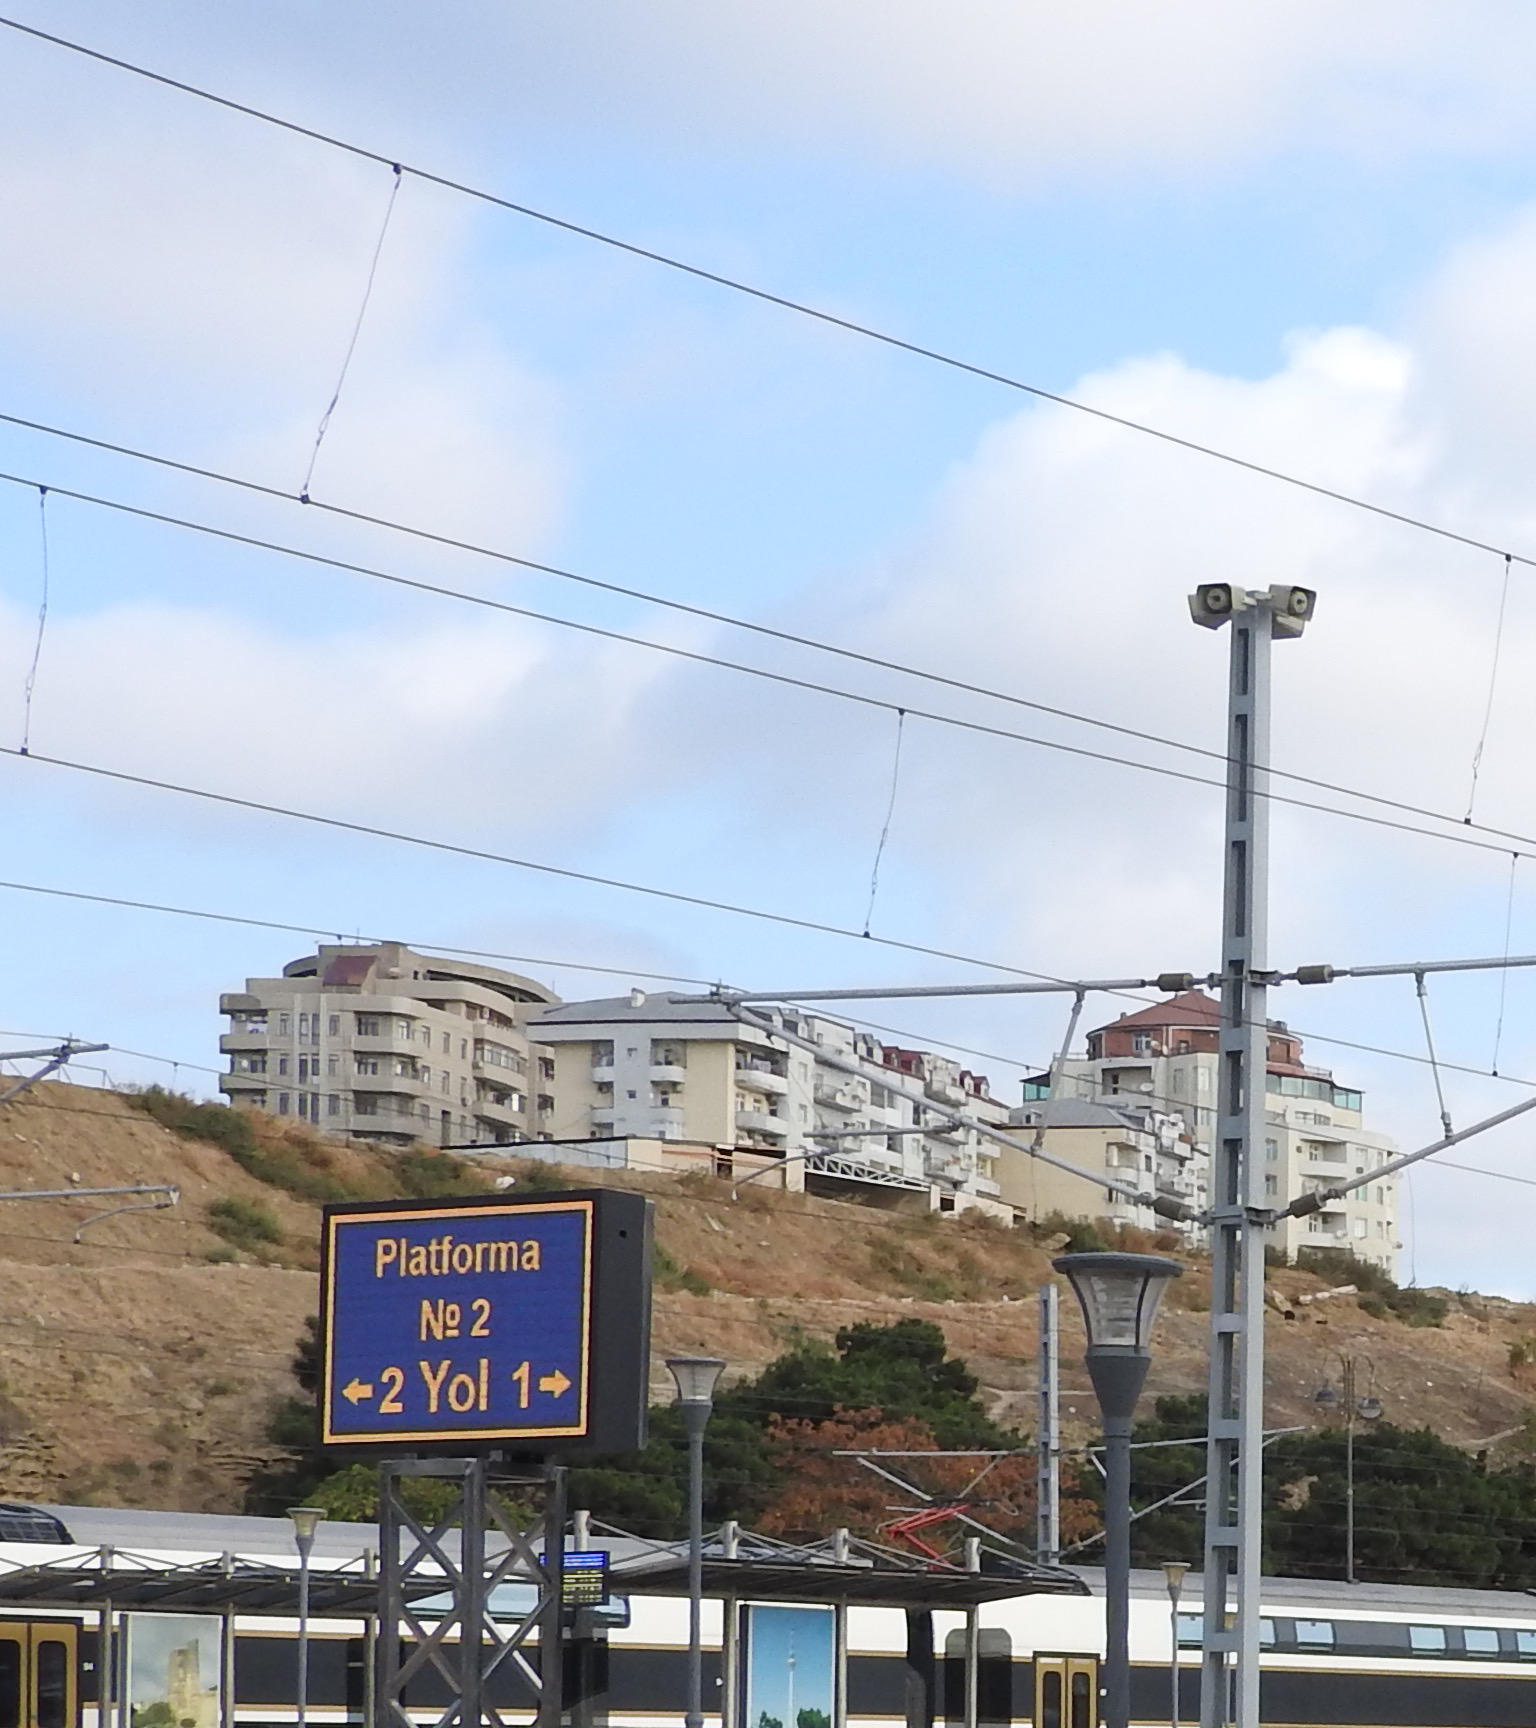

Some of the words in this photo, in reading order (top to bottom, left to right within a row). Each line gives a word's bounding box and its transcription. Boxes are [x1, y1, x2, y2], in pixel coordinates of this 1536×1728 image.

[375, 1235, 541, 1278] Platforma
[470, 1298, 491, 1338] 2
[378, 1366, 405, 1414] 2
[419, 1357, 490, 1414] Yol
[511, 1360, 531, 1410] 1
